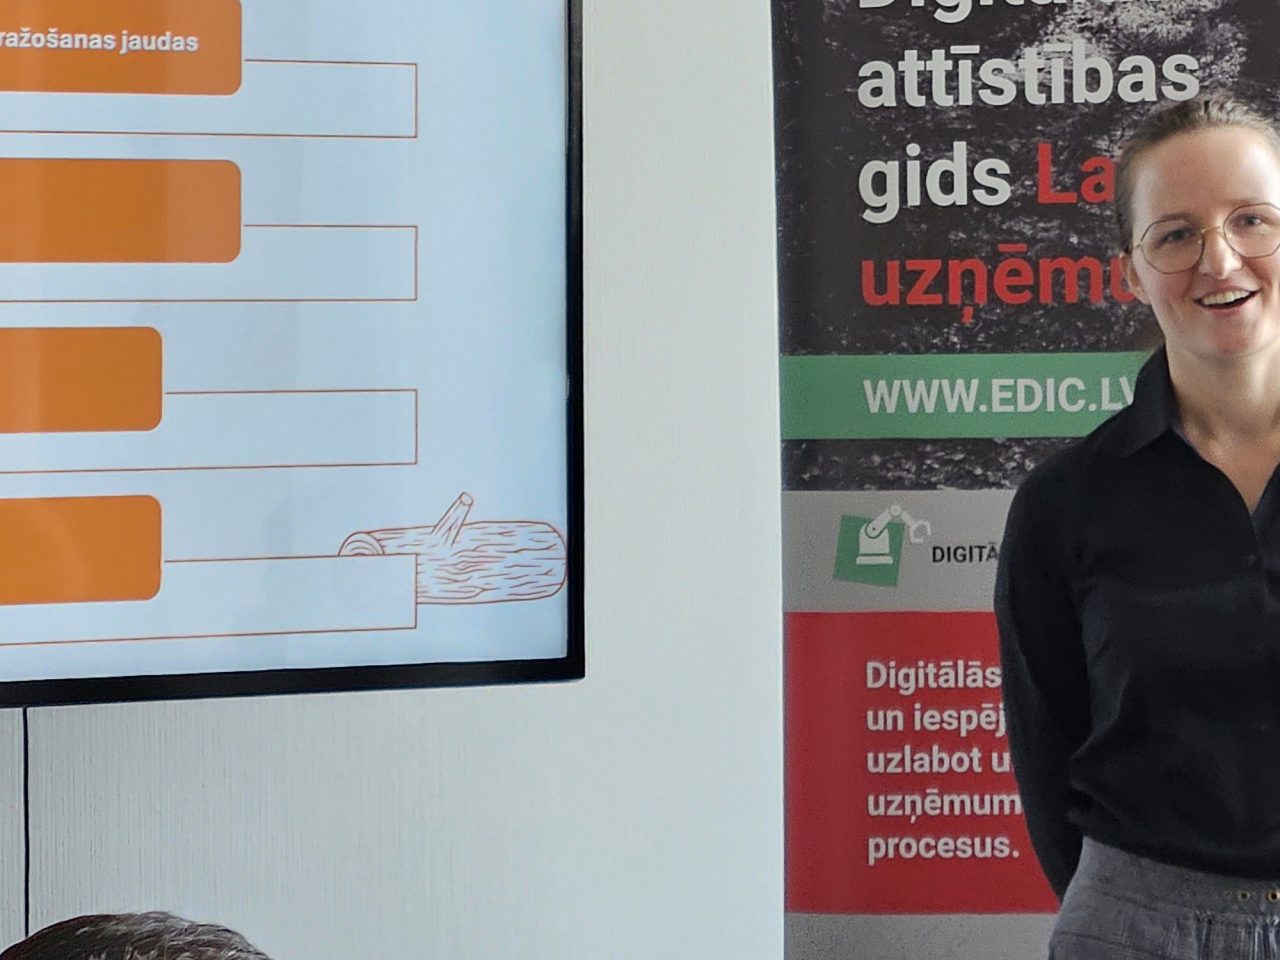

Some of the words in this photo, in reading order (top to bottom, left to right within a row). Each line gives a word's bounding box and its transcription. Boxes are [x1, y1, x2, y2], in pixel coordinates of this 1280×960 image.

[0, 27, 116, 50] ražošanas
[119, 30, 198, 54] jaudas
[858, 42, 1200, 107] attīstības
[858, 142, 1011, 224] gids
[932, 541, 999, 563] DIGITĀ
[866, 660, 1003, 695] Digitālās
[867, 709, 904, 731] un
[914, 703, 1006, 737] iespēj
[867, 745, 982, 773] uzlabot
[868, 789, 1023, 824] uzņēmum
[868, 836, 1020, 866] procesus.
